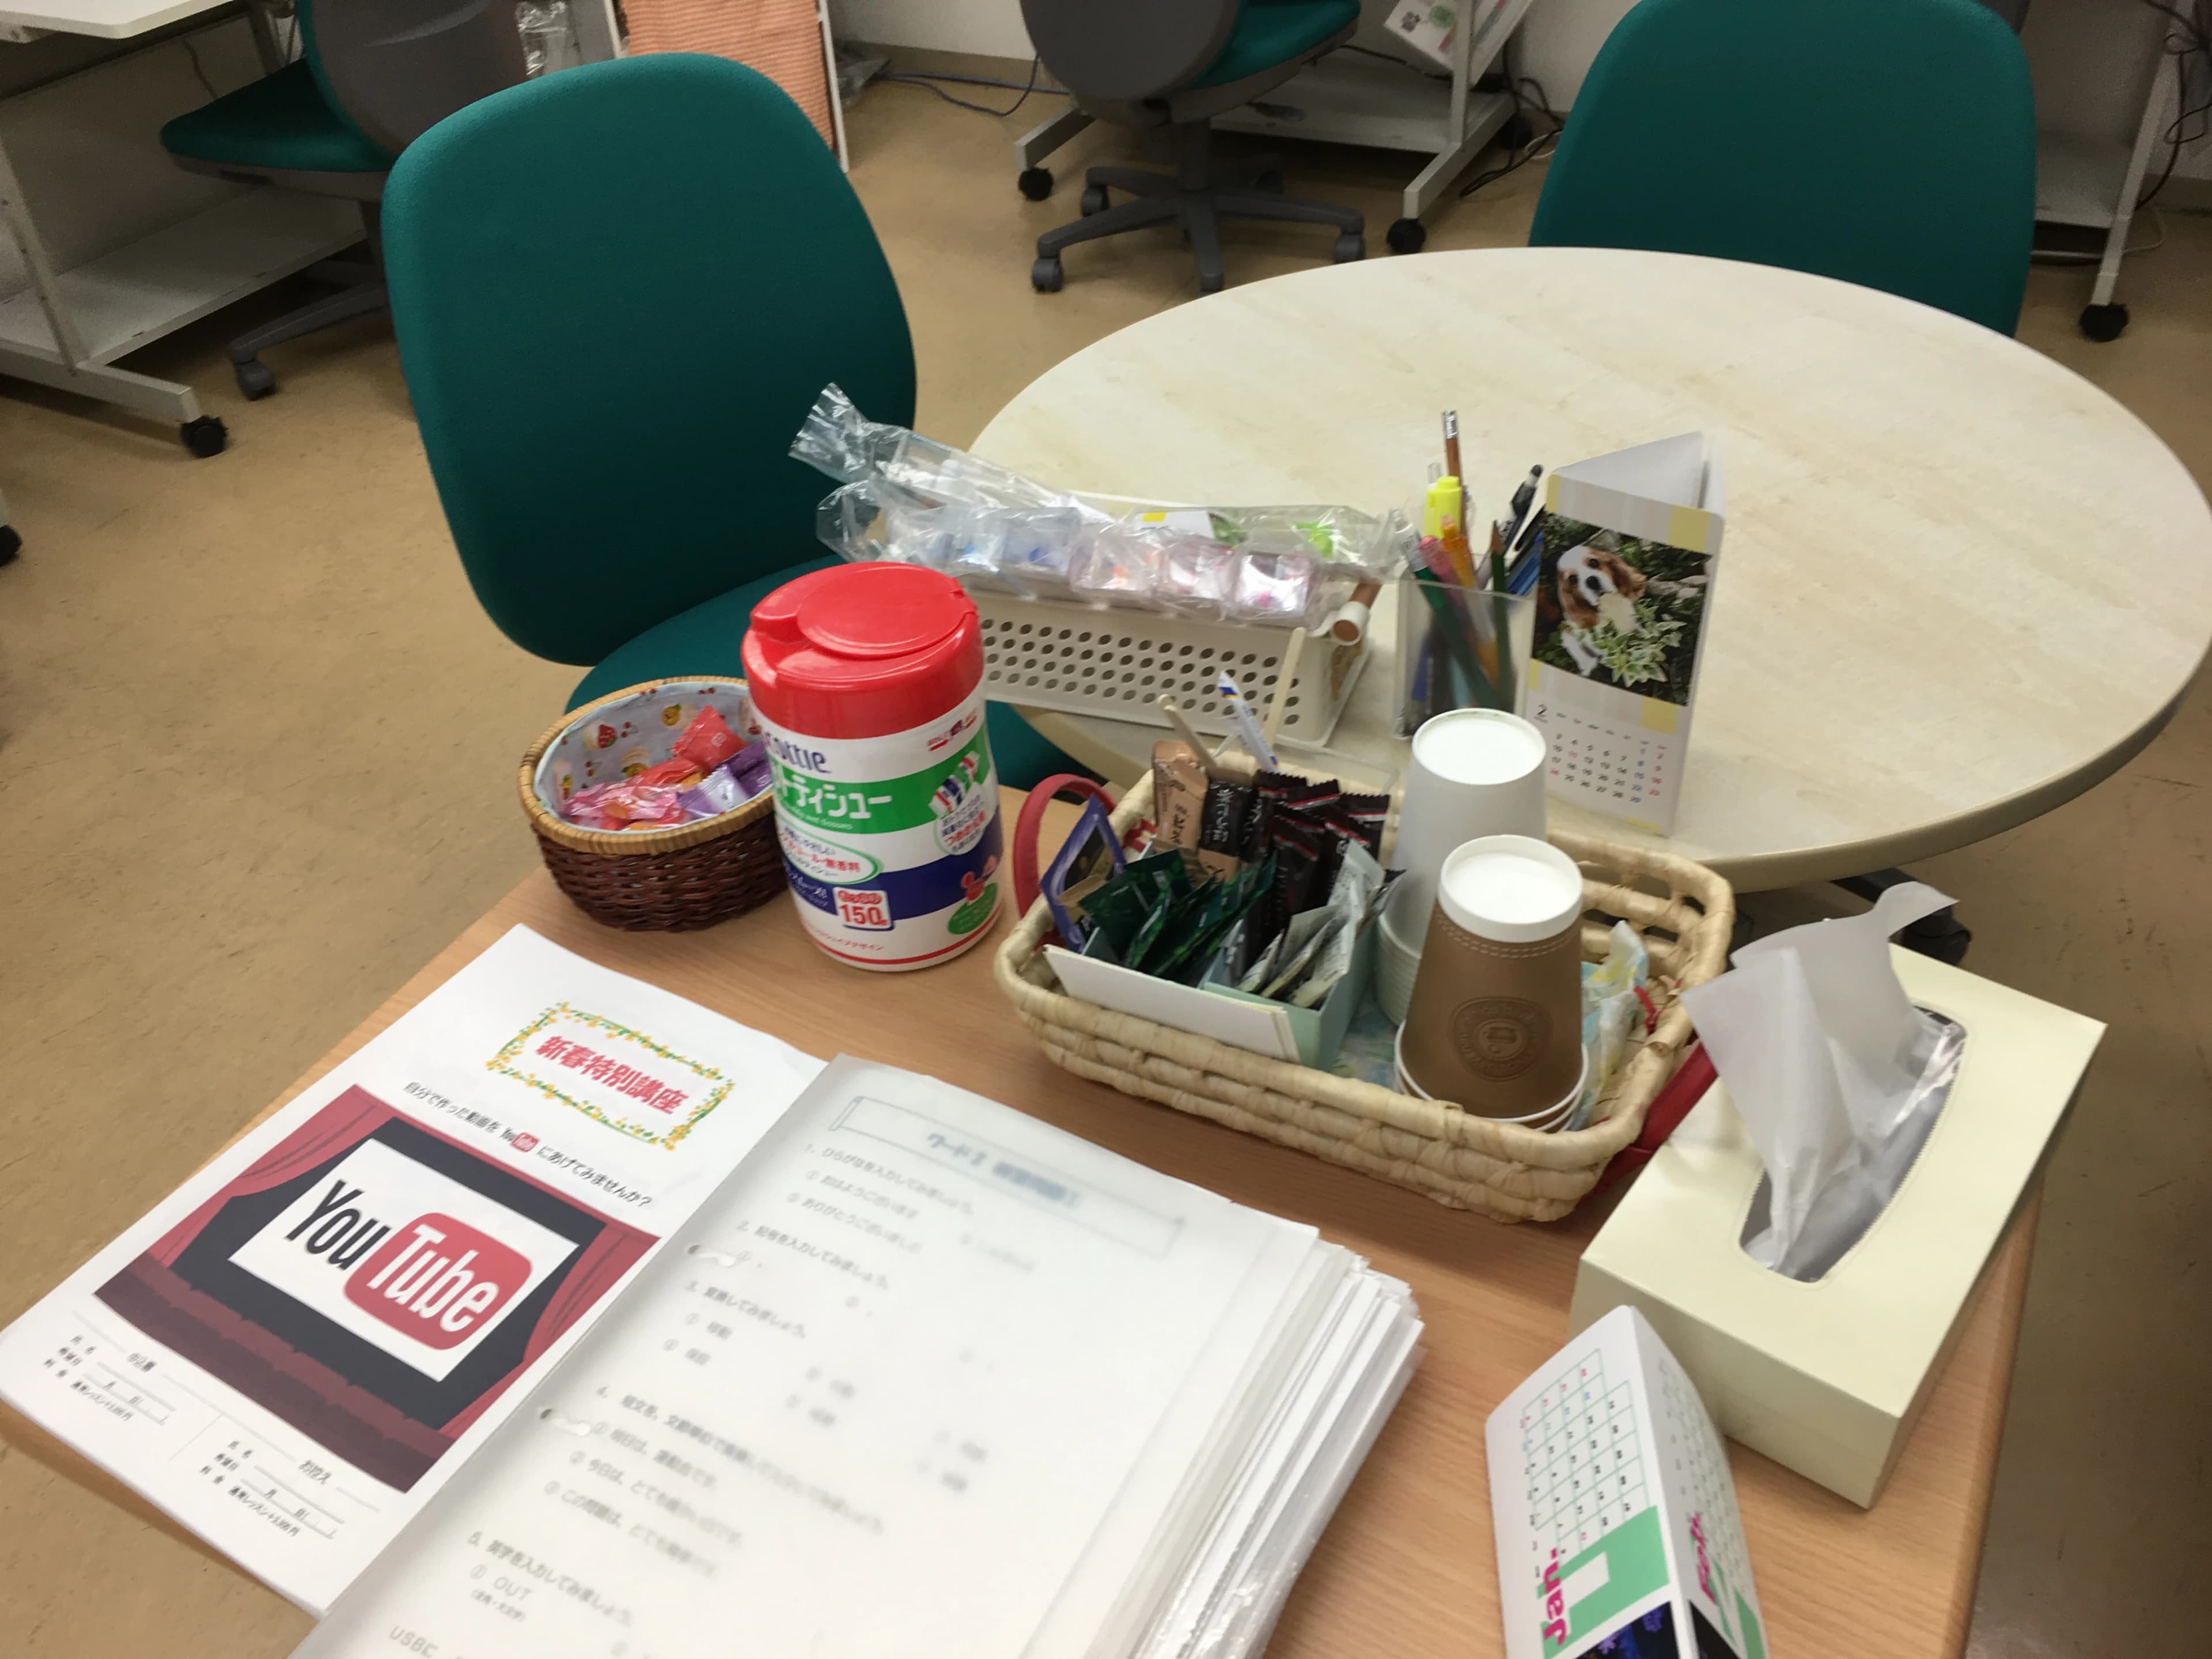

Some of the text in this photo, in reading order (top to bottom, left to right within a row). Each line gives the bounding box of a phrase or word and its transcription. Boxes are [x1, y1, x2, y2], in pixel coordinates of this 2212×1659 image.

[534, 1035, 691, 1116] 新春特別講座
[284, 1180, 499, 1333] YouTube
[493, 1576, 533, 1601] OUT
[1542, 1547, 1567, 1646] Jan.
